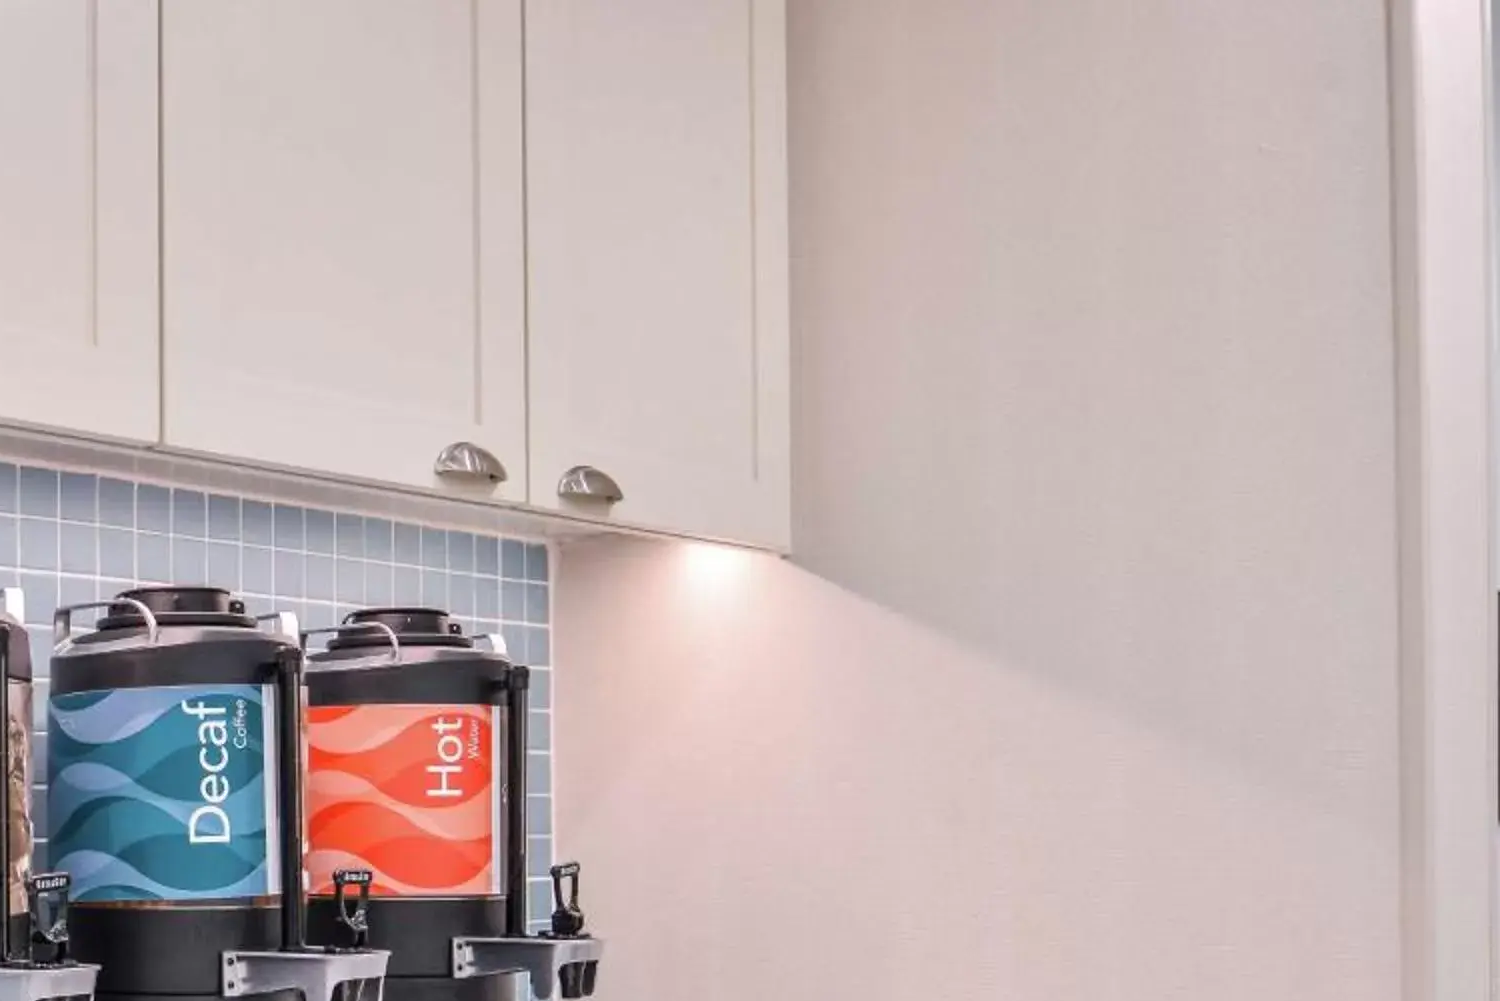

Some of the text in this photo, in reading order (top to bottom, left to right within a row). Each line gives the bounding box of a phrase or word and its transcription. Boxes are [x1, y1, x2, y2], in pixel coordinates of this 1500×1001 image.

[232, 699, 248, 749] Coffee
[425, 717, 463, 796] Hot
[181, 699, 231, 843] Decaf
